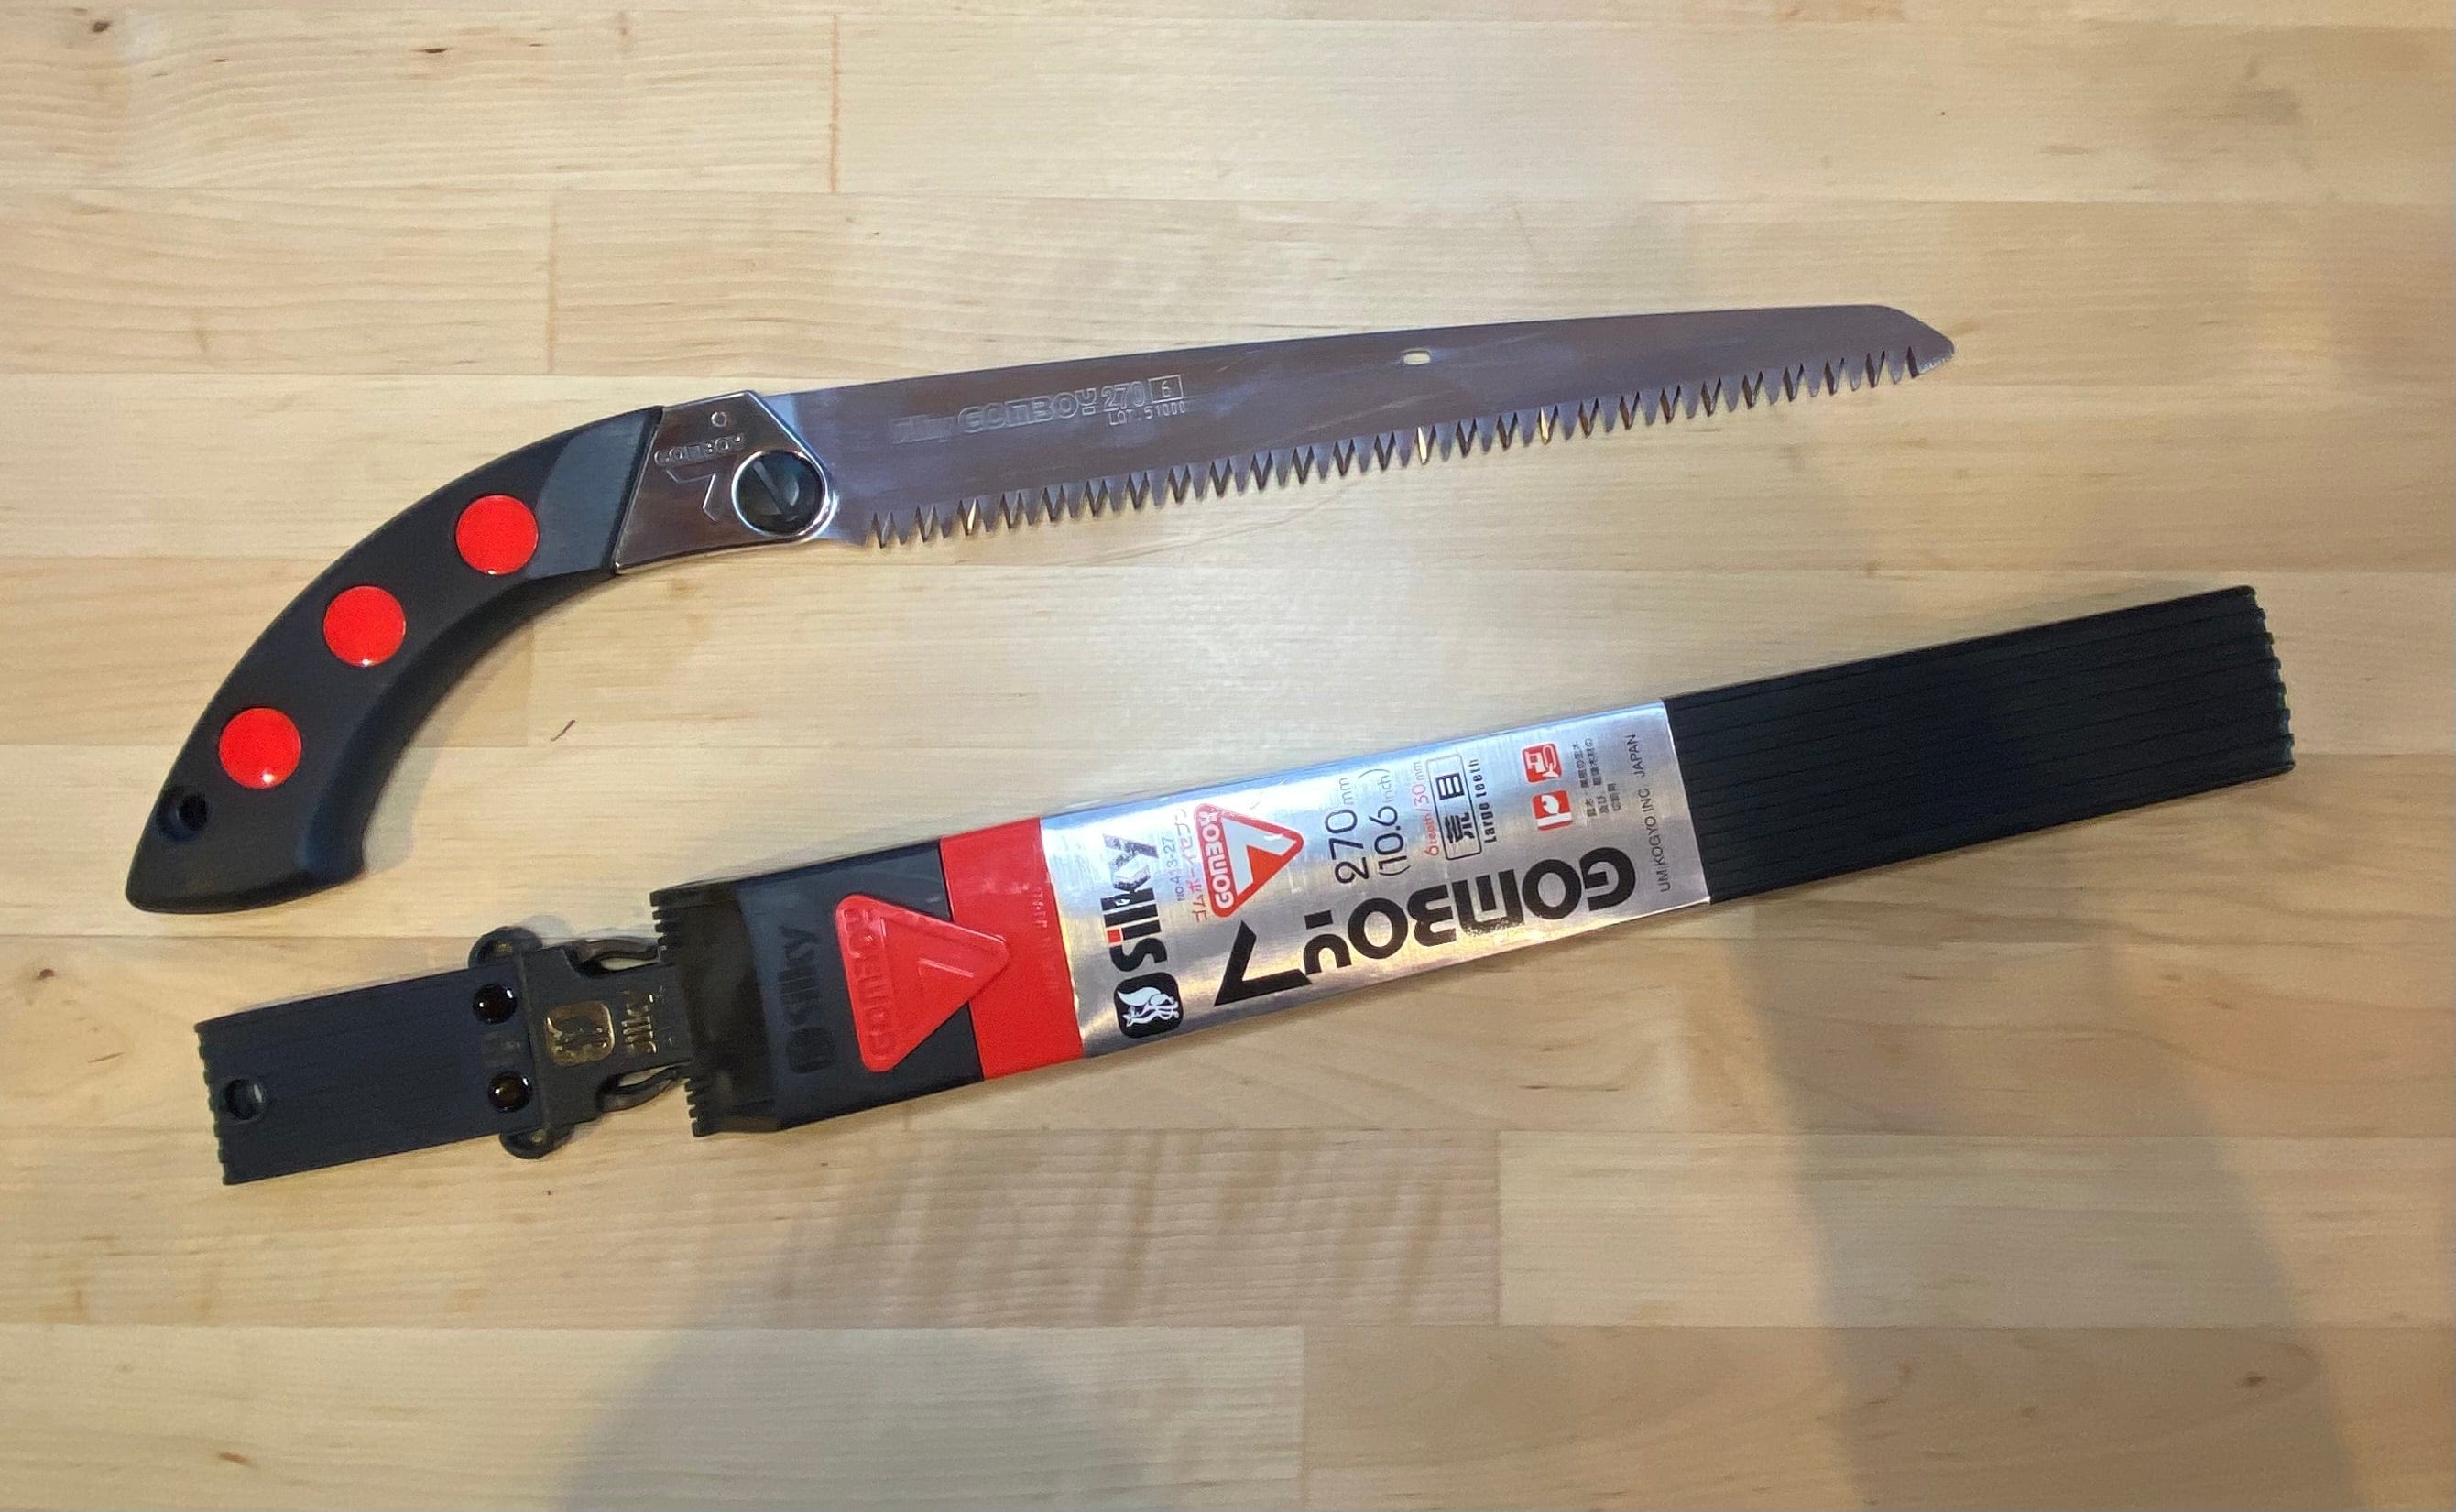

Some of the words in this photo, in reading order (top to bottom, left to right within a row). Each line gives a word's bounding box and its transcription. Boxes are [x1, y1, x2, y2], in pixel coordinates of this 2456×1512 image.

[957, 388, 1097, 433] GOMBOY
[1101, 381, 1147, 408] 270
[1626, 734, 1645, 778] JAPAN
[1434, 772, 1475, 844] 荒目
[1479, 801, 1497, 844] Large
[1198, 810, 1235, 909] GOMBOY
[1100, 833, 1168, 972] Silky
[1302, 846, 1637, 974] GOMBOY
